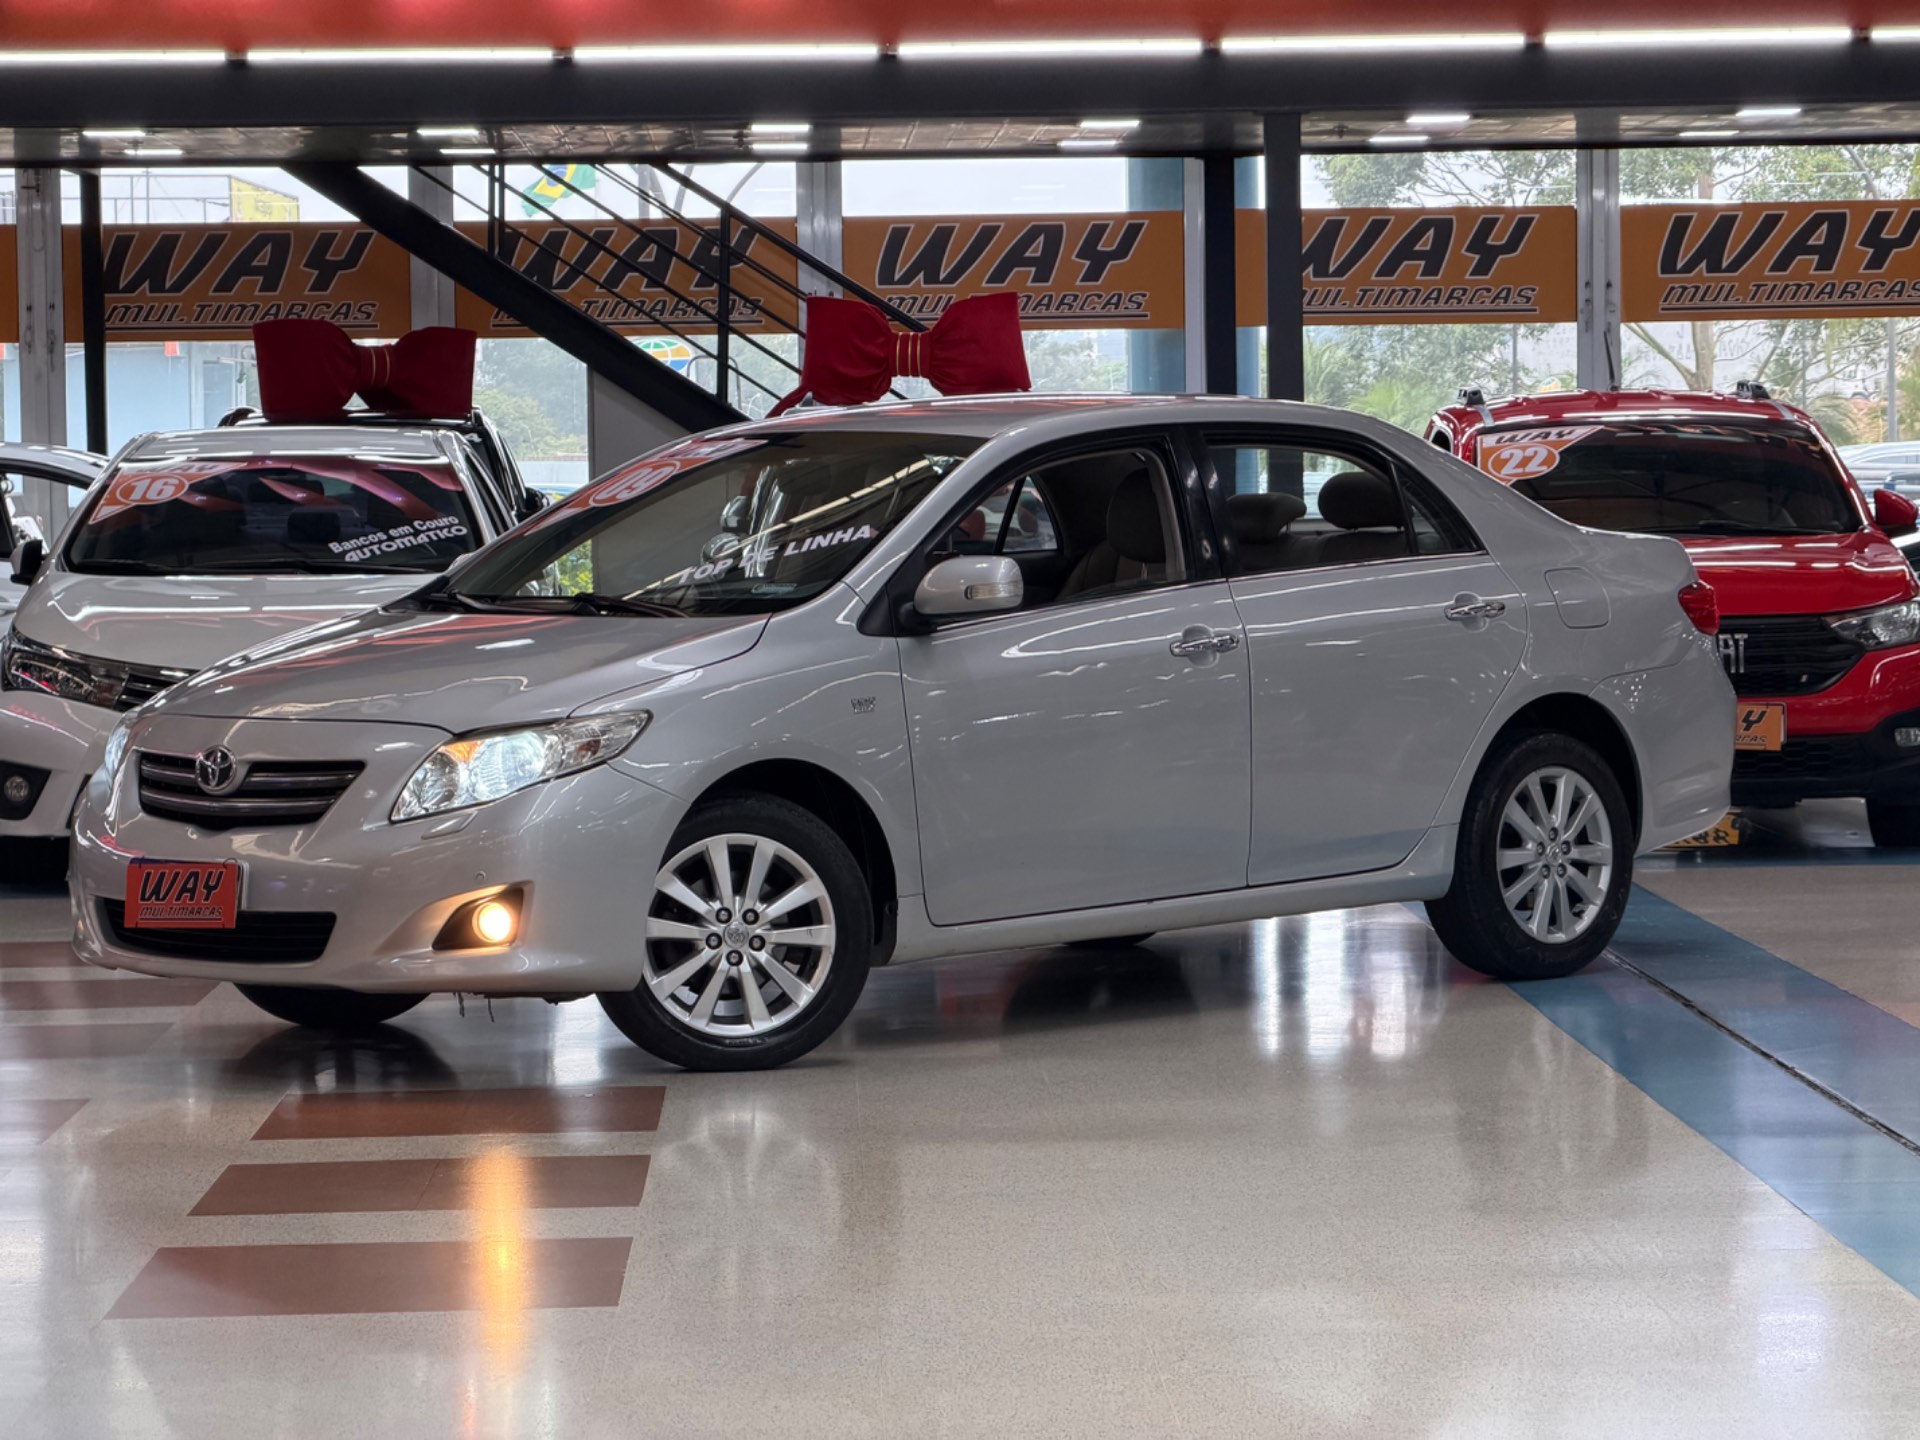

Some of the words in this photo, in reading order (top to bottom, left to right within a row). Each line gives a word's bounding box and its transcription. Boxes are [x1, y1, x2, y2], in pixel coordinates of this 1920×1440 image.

[496, 226, 758, 293] WAY
[875, 219, 1149, 288] WAY
[1303, 214, 1541, 281] WAY
[1657, 208, 1920, 278] WAY
[104, 229, 377, 297] WAY
[104, 300, 380, 325] MULTIMARCAS
[1494, 429, 1577, 445] WAY
[1500, 447, 1549, 475] 22
[129, 478, 179, 501] 16
[328, 531, 388, 554] Bancos
[388, 524, 414, 538] em
[412, 515, 459, 531] Couro
[679, 558, 733, 585] TOP
[738, 545, 779, 570] DE
[783, 524, 871, 557] LINHA
[1719, 634, 1748, 673] AT
[138, 869, 225, 904] WAY
[139, 906, 223, 918] MULTIMARCAS
